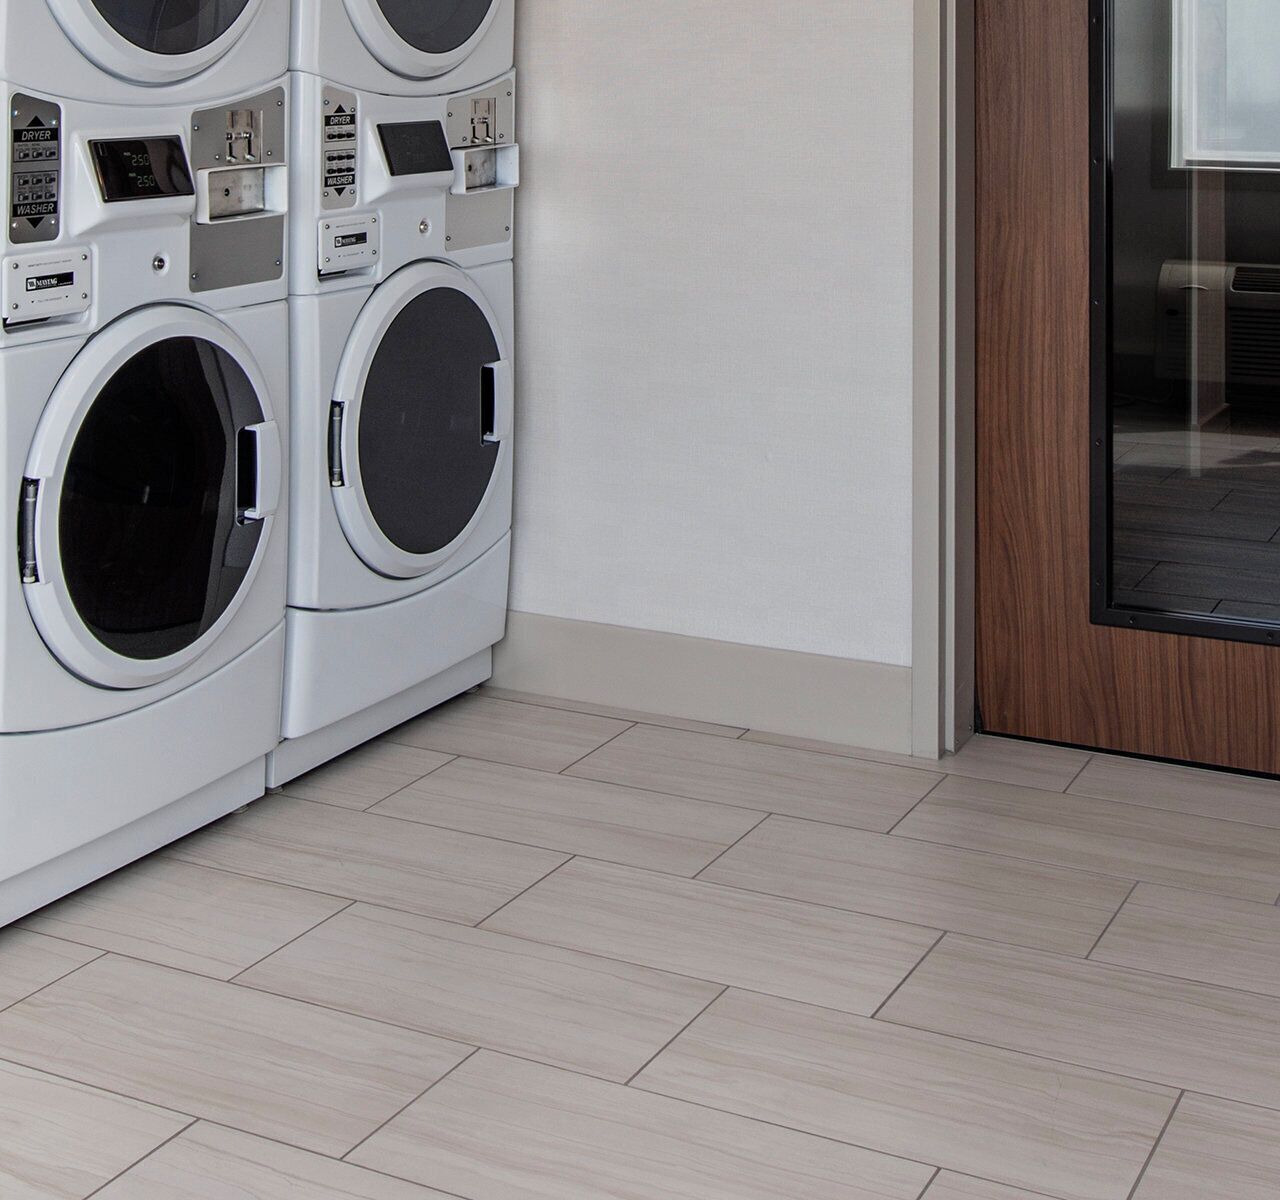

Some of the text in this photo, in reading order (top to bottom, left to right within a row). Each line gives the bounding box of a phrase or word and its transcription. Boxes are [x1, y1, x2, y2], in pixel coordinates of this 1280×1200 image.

[329, 116, 351, 125] DRYER
[21, 130, 51, 141] DRYER
[327, 175, 353, 186] WASHER
[17, 202, 55, 215] WASHER
